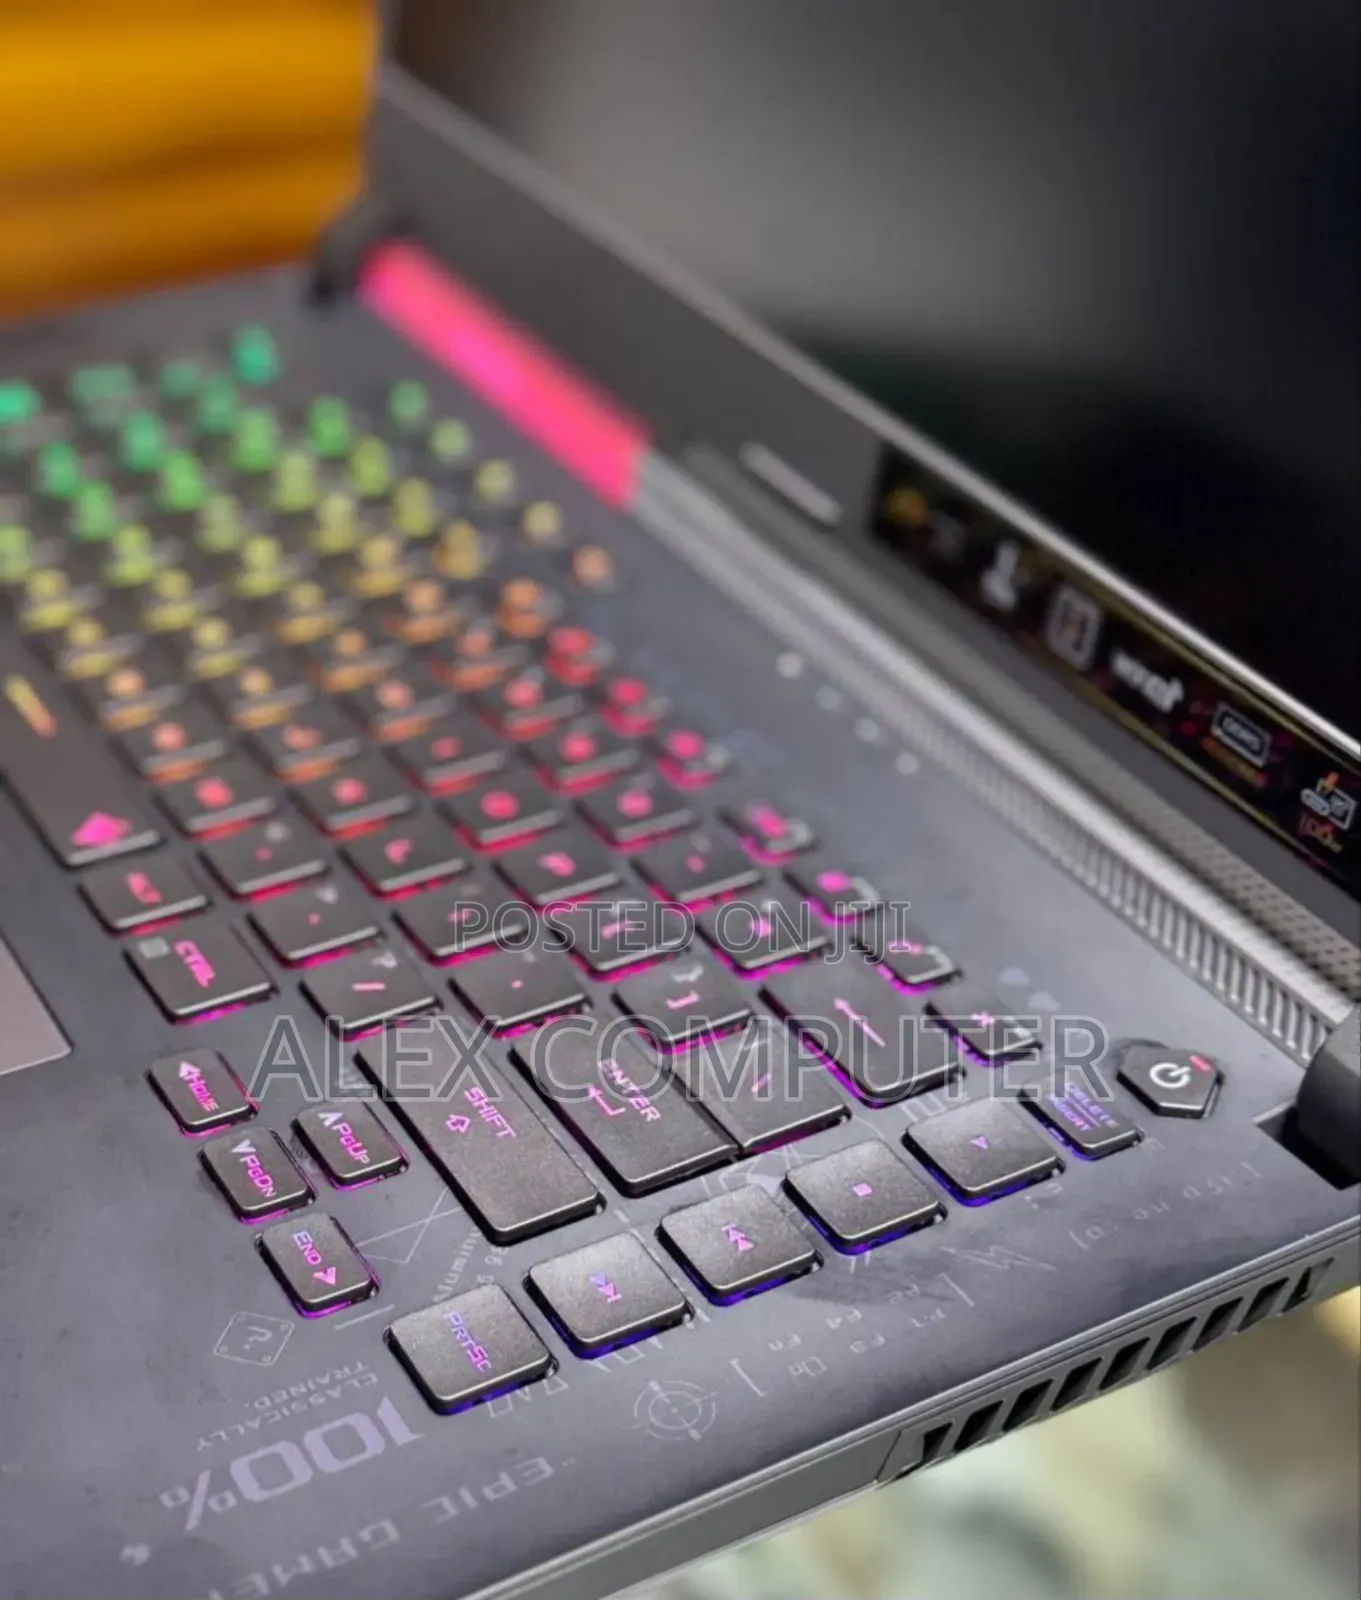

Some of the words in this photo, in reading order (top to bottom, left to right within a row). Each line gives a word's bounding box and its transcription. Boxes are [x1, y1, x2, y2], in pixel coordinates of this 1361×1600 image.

[464, 1085, 518, 1141] SHIFT
[598, 1058, 661, 1123] ENTER
[198, 1373, 379, 1451] CLASSICALLY
[159, 1393, 426, 1533] 100%
[208, 1517, 399, 1600] GAME
